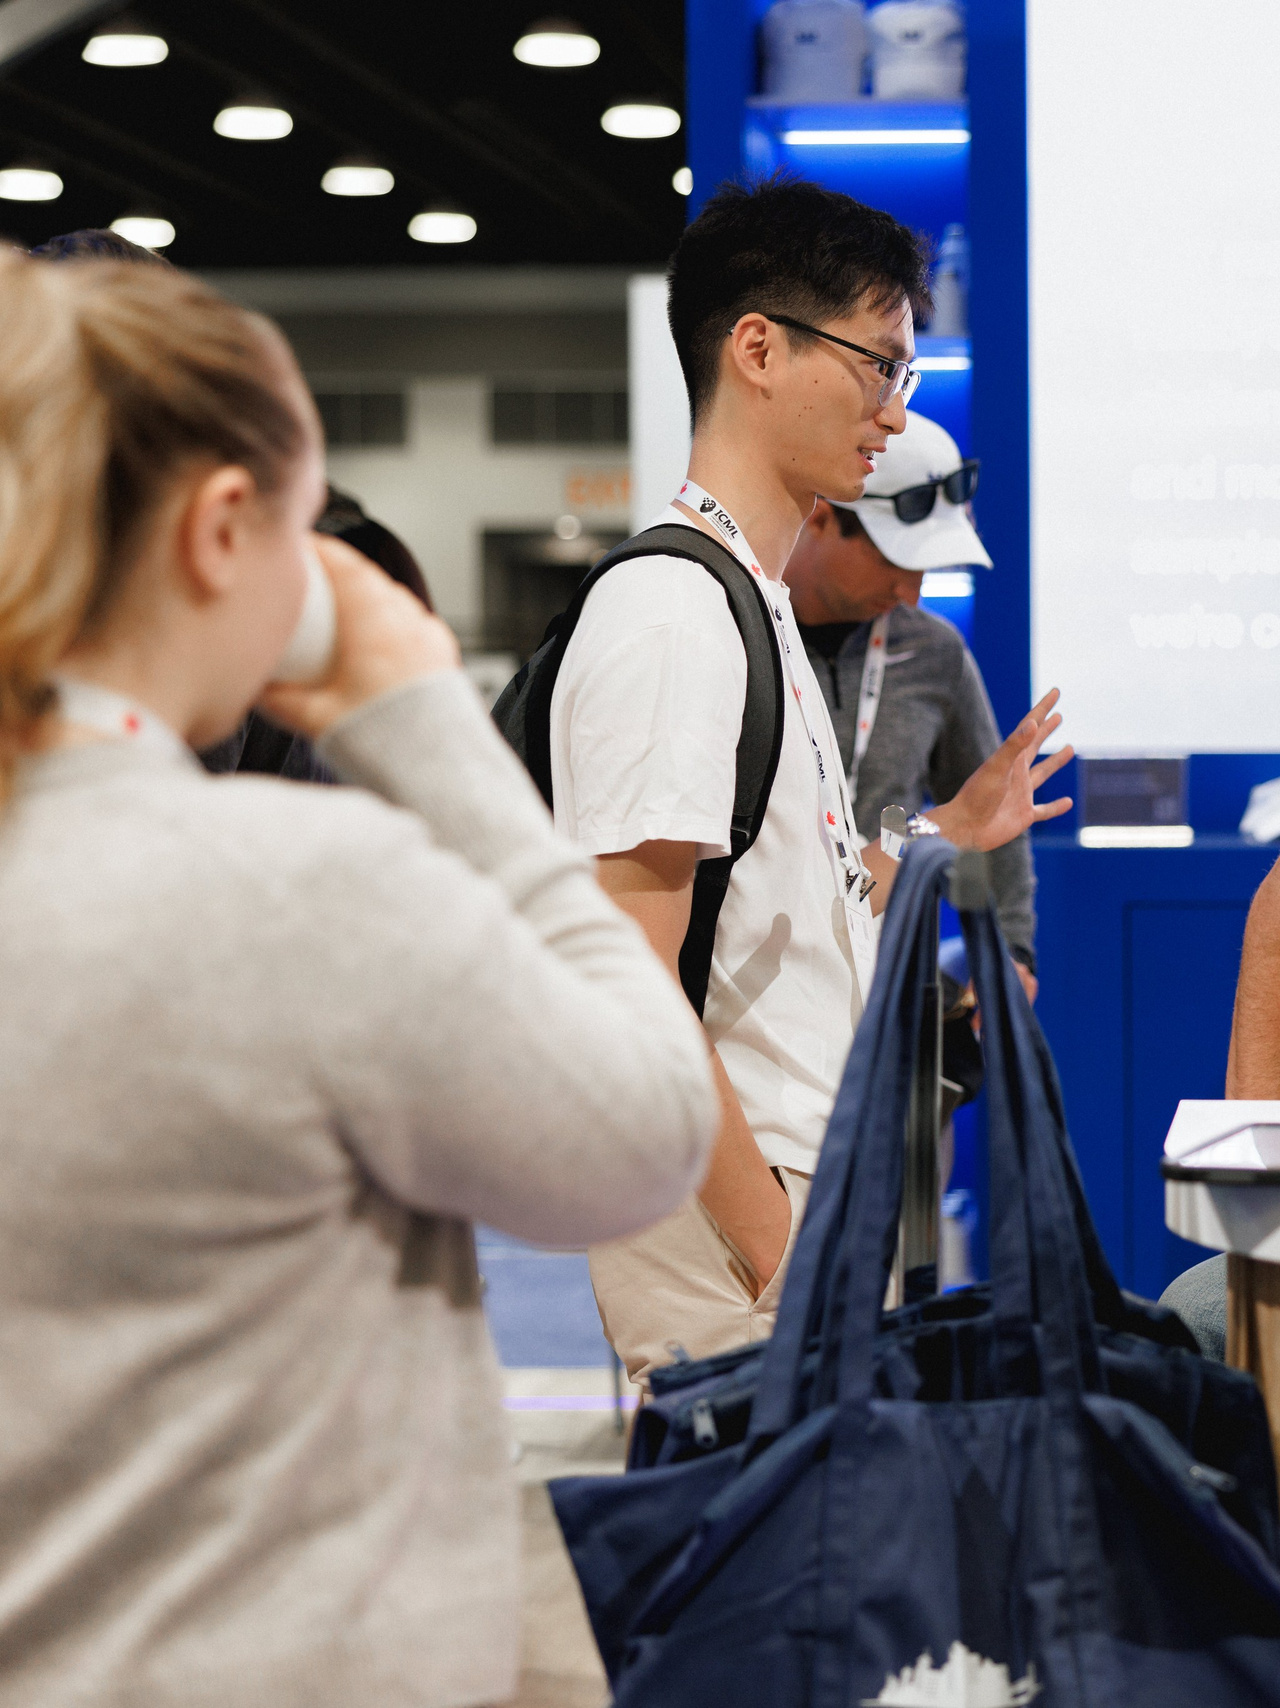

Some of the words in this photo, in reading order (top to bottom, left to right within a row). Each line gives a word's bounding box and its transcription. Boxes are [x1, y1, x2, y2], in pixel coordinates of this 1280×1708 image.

[1131, 454, 1216, 500] and
[713, 509, 739, 539] ICML
[1129, 602, 1244, 649] we're
